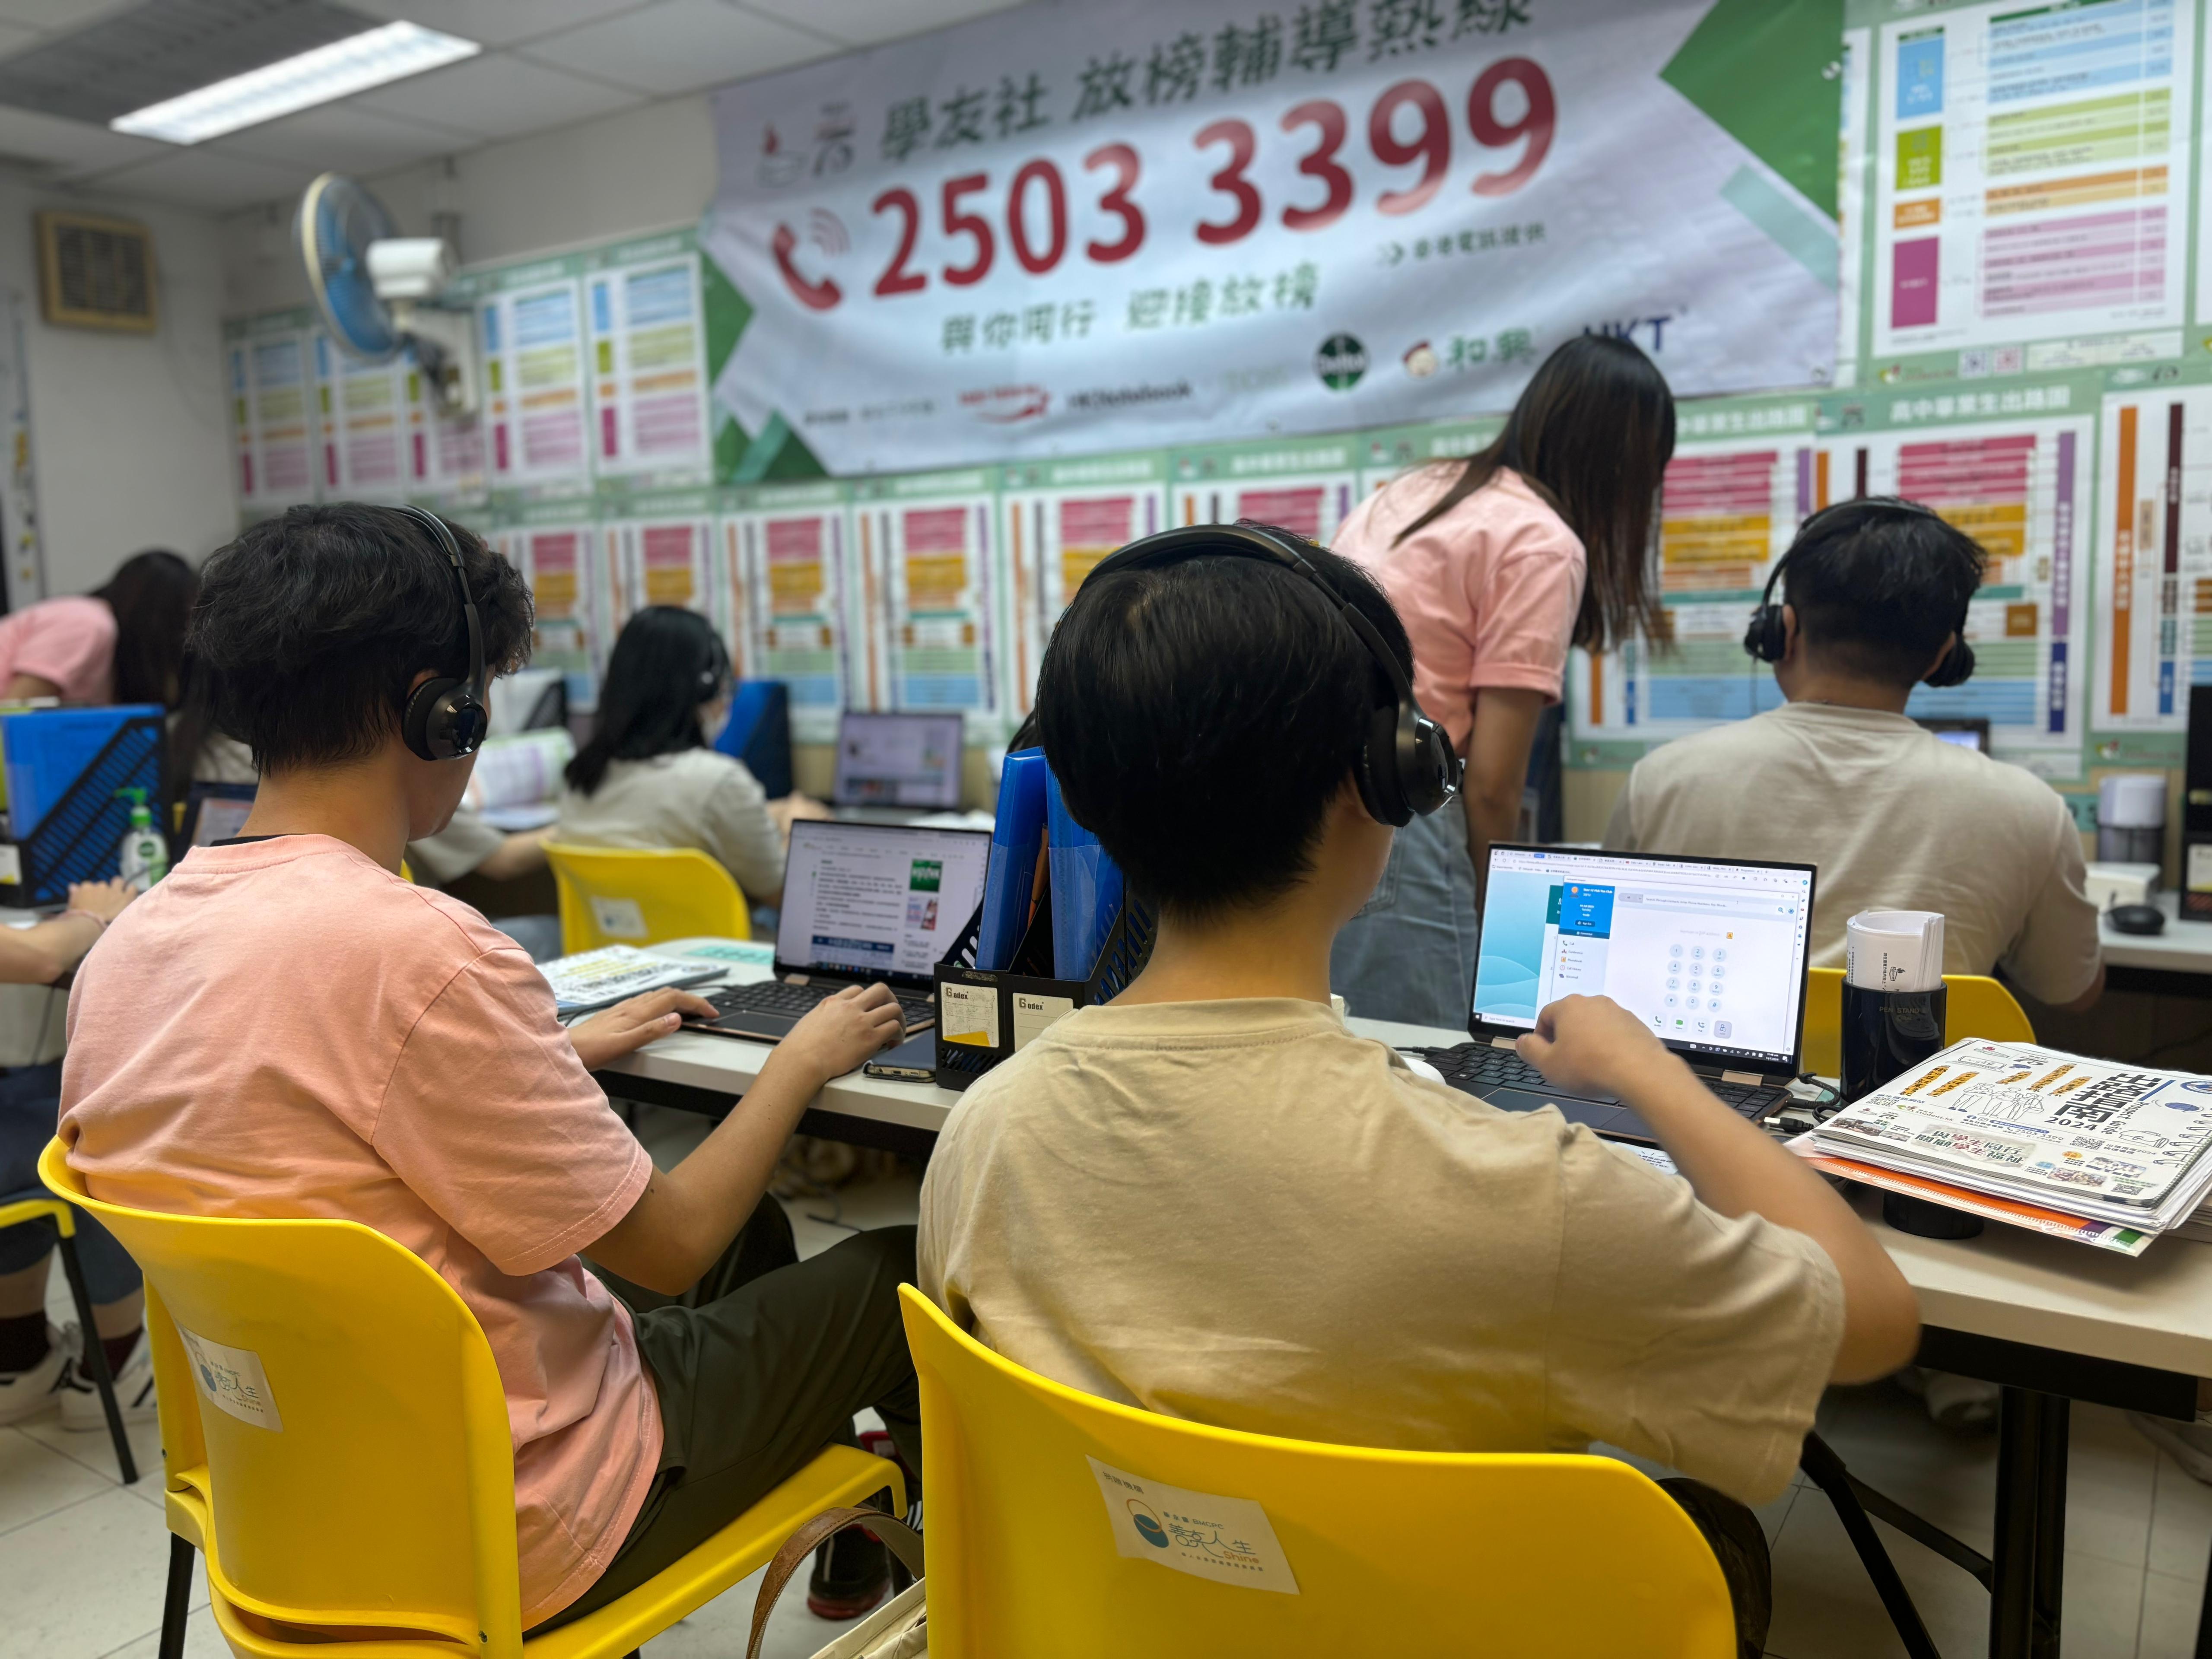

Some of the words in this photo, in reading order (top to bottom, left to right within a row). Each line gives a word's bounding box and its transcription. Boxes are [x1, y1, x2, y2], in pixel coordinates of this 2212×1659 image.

[882, 72, 1050, 163] 學友社
[1070, 0, 1534, 123] 放榜輔導熱線
[870, 142, 1148, 298] 2503
[1192, 56, 1556, 247] 3399
[941, 299, 1095, 354] 與你同行
[1124, 261, 1319, 330] 迎接放榜
[945, 987, 969, 1000] Godex
[1019, 998, 1044, 1011] Godex
[2053, 1073, 2163, 1123] 出路指南
[1915, 1110, 1954, 1122] student.hk
[2116, 1101, 2150, 1120] Prospect
[2044, 1116, 2098, 1131] 2024
[2101, 1120, 2126, 1135] Guide
[1915, 1134, 2024, 1164] 關顧學生福祉
[1931, 1130, 2023, 1155] 與學生同行
[2105, 1144, 2157, 1155] 出路指南2024
[1192, 1519, 1224, 1530] BMCPC
[1223, 1550, 1260, 1564] Shine
